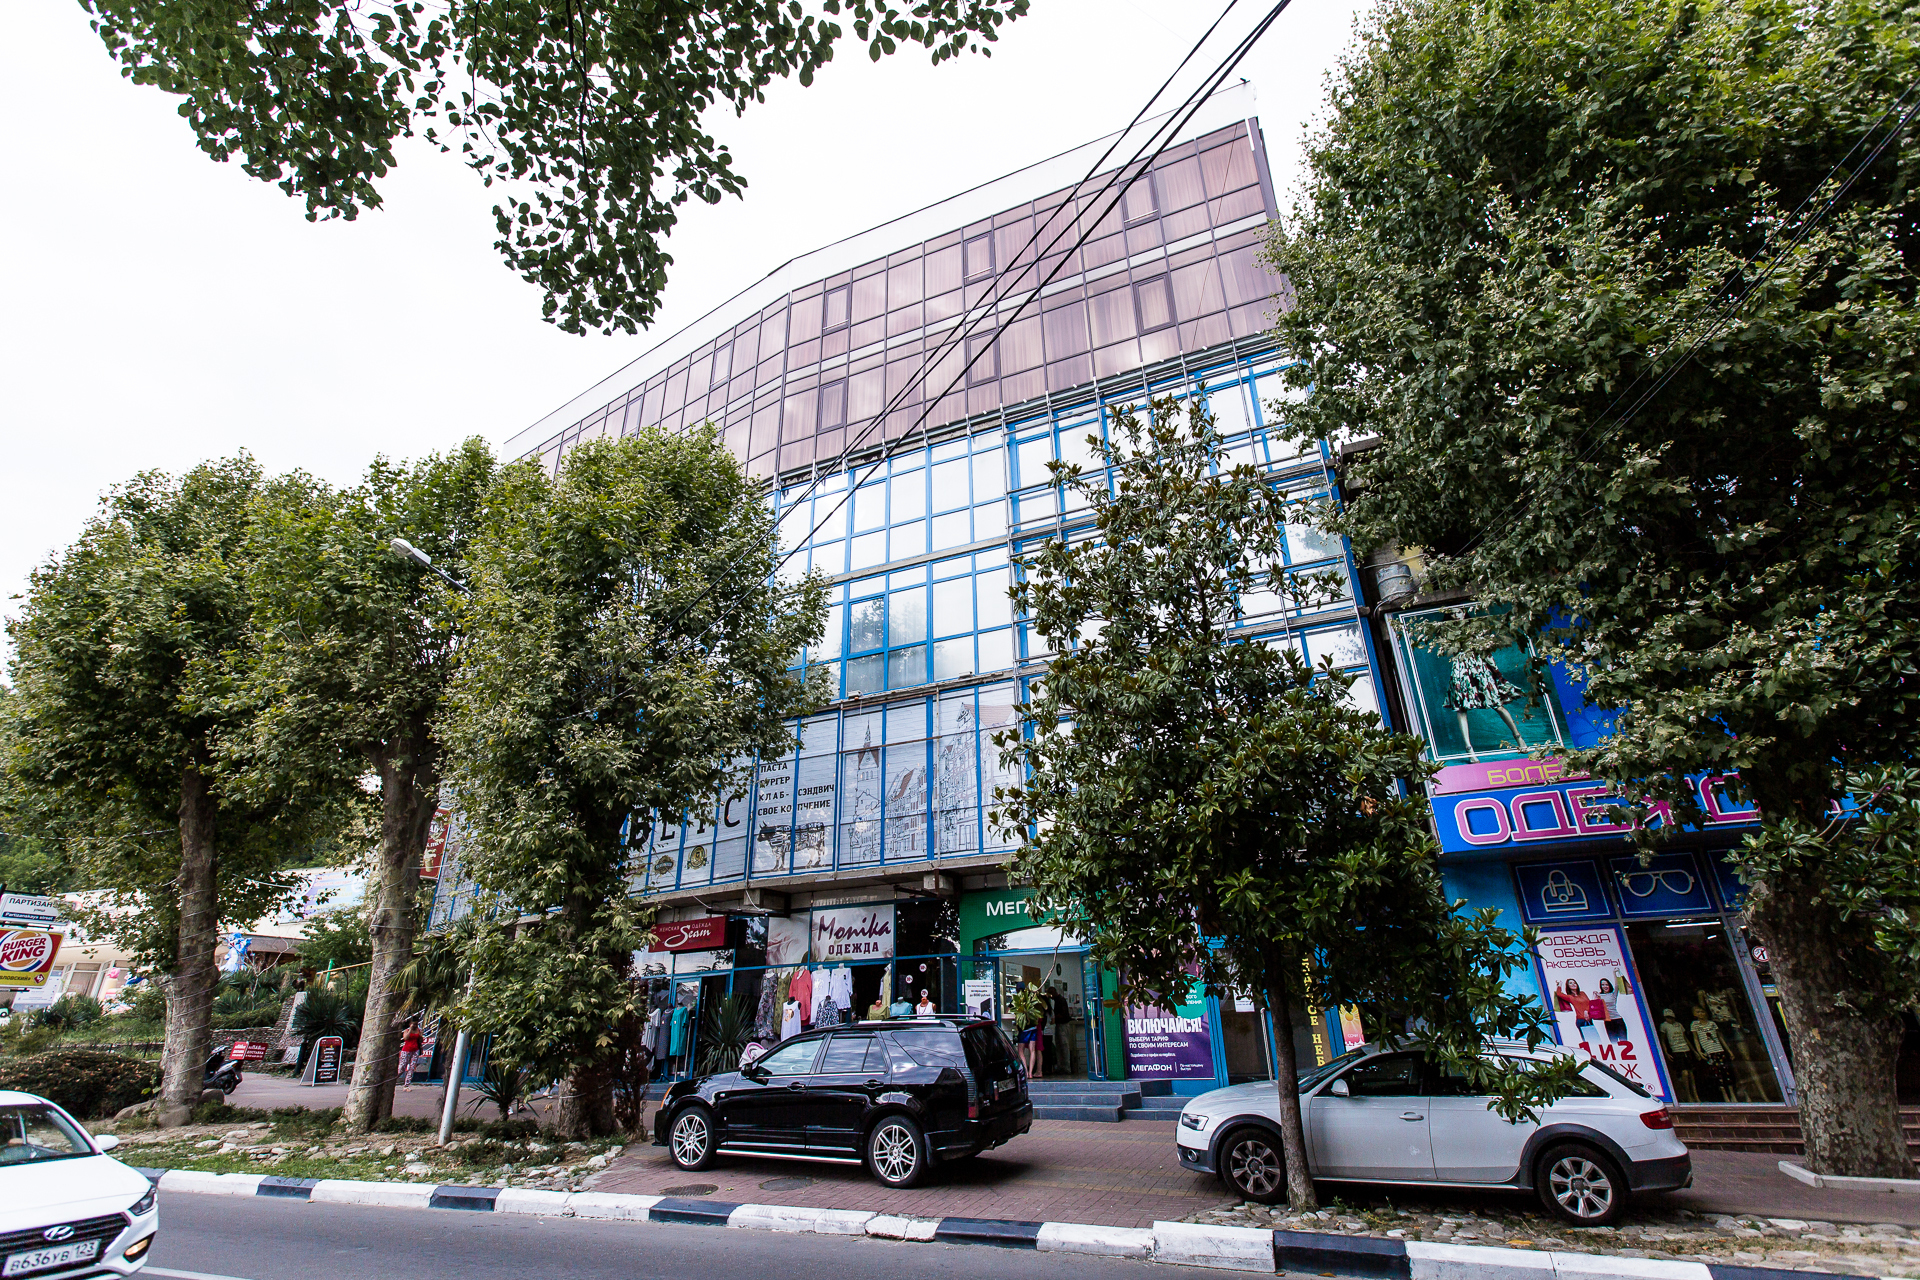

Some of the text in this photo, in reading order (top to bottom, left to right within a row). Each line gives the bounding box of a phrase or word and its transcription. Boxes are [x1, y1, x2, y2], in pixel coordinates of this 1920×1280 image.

[760, 763, 788, 773] ПАСТА
[798, 784, 835, 796] СЭНДВИЧ
[757, 806, 778, 816] СВОЕ
[691, 922, 712, 930] ОДЕЖДА
[817, 912, 892, 942] Monika
[1, 937, 47, 953] BURGER
[1543, 933, 1612, 947] ОДЕЖДА
[0, 945, 46, 964] KING
[828, 941, 880, 957] ОДЕЖДА
[1553, 946, 1607, 959] ОБУВЬ
[1545, 958, 1622, 969] АКСЕССУАРЫ
[1127, 1016, 1203, 1035] ВКЛЮЧАЙСЯ!
[1617, 1040, 1637, 1061] 2
